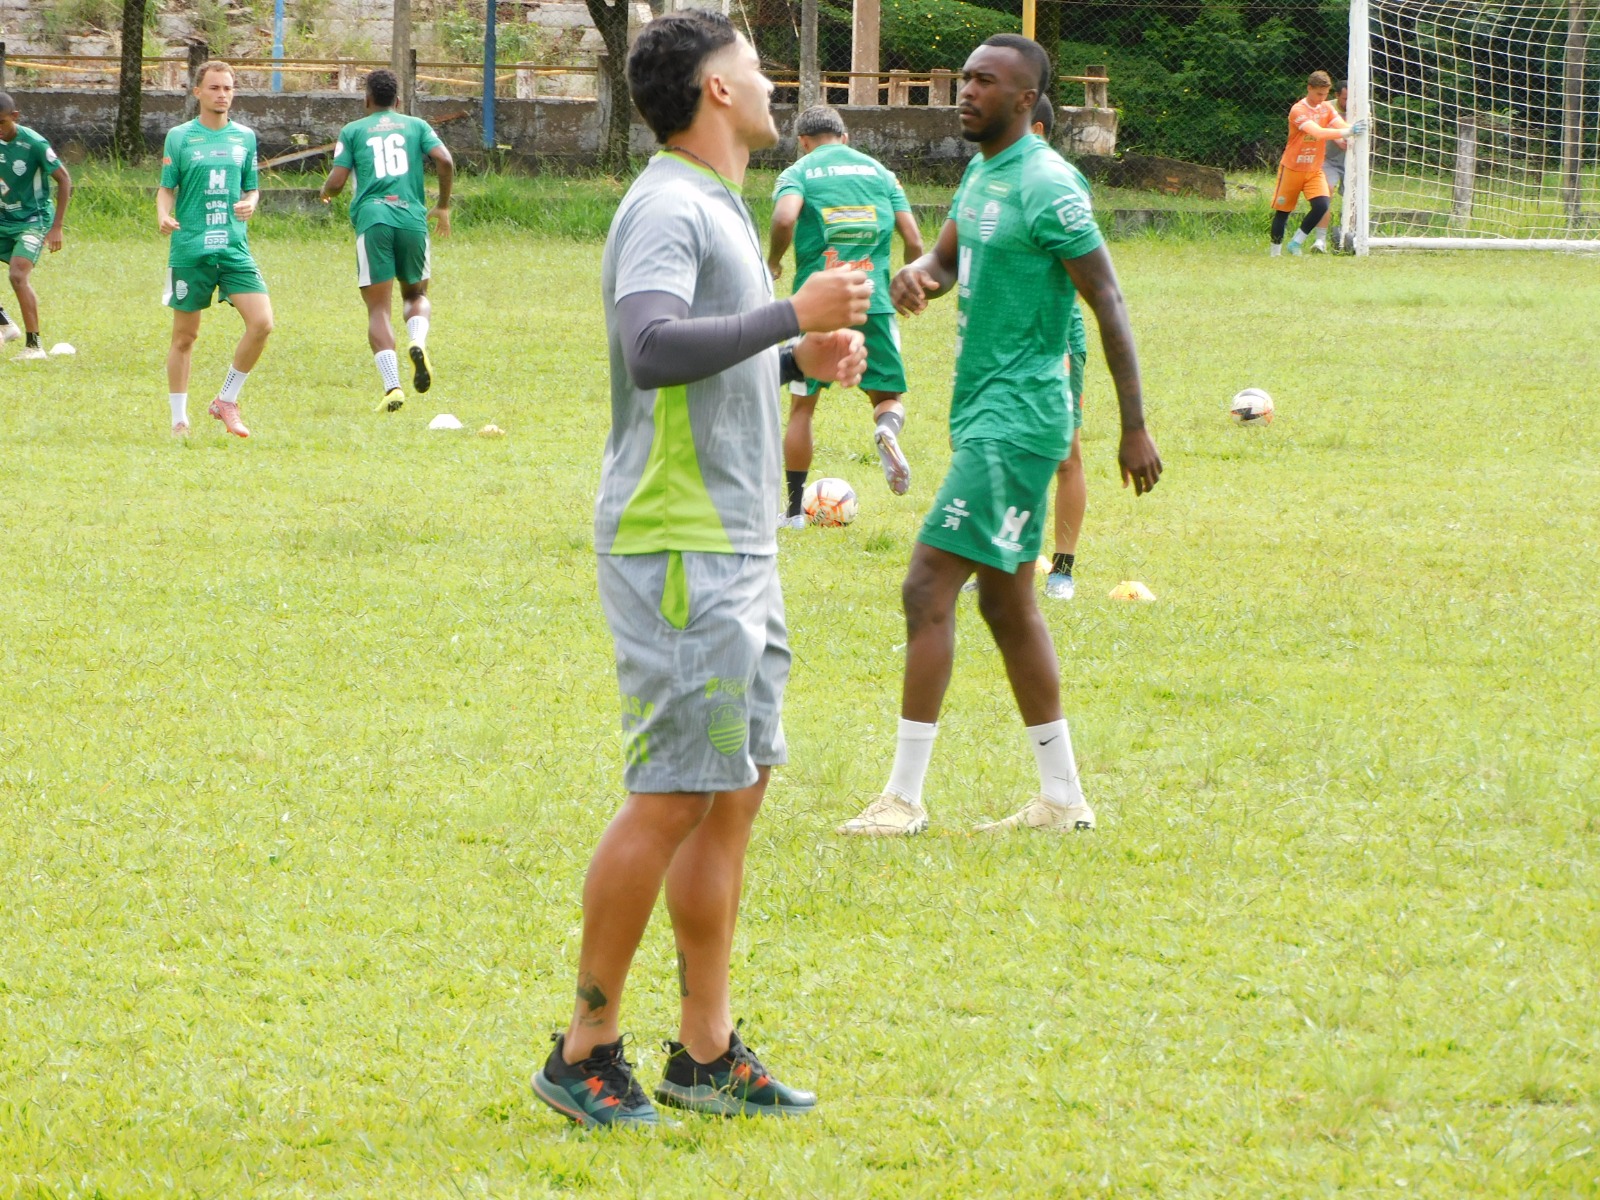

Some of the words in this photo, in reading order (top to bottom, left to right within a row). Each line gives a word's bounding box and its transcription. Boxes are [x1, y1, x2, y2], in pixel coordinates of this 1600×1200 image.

[366, 133, 409, 179] 16
[209, 169, 226, 190] H
[205, 200, 228, 210] CASA
[206, 212, 228, 226] FIAT
[997, 506, 1031, 542] H
